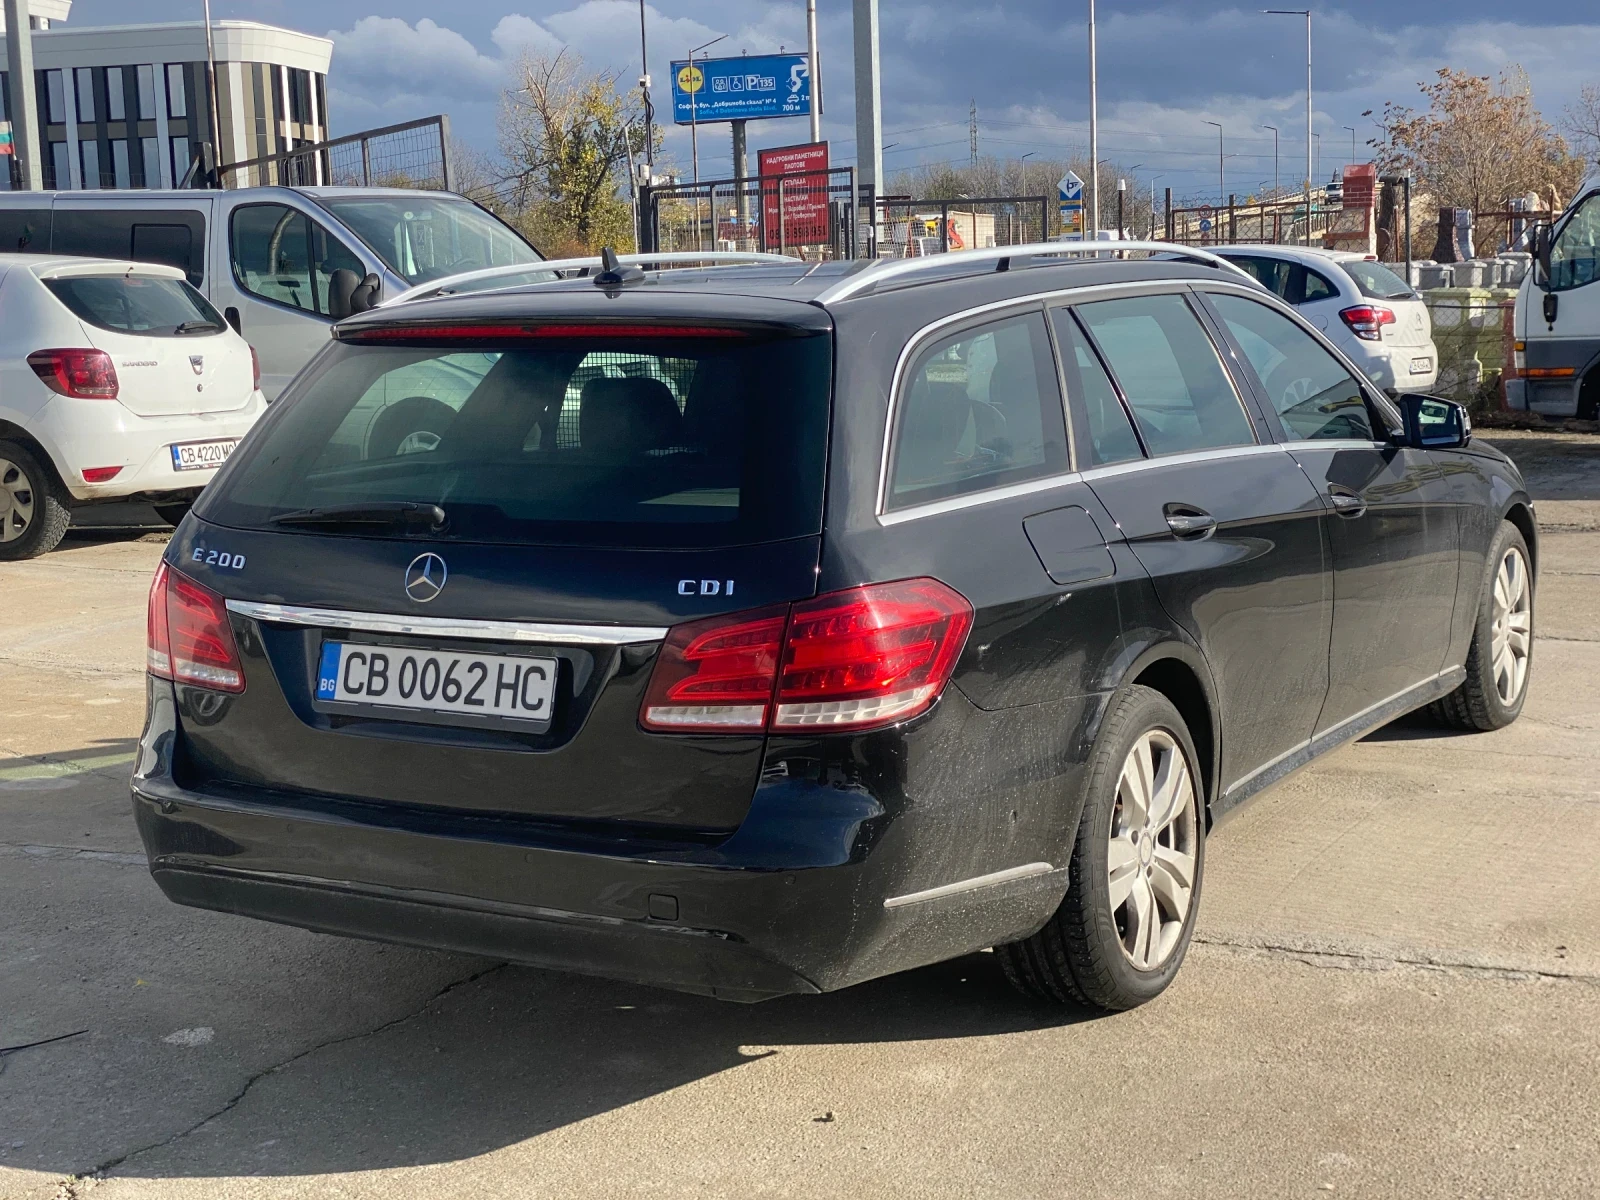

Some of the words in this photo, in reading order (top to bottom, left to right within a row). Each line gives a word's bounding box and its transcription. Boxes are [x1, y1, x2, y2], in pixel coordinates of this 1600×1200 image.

[760, 79, 773, 87] 135
[766, 154, 794, 164] НАДГРОБНИ
[794, 150, 824, 160] ПАМЕТНИЦИ
[197, 445, 221, 462] 4220
[678, 579, 735, 596] CDI
[320, 678, 336, 692] BG
[398, 655, 489, 708] 0062
